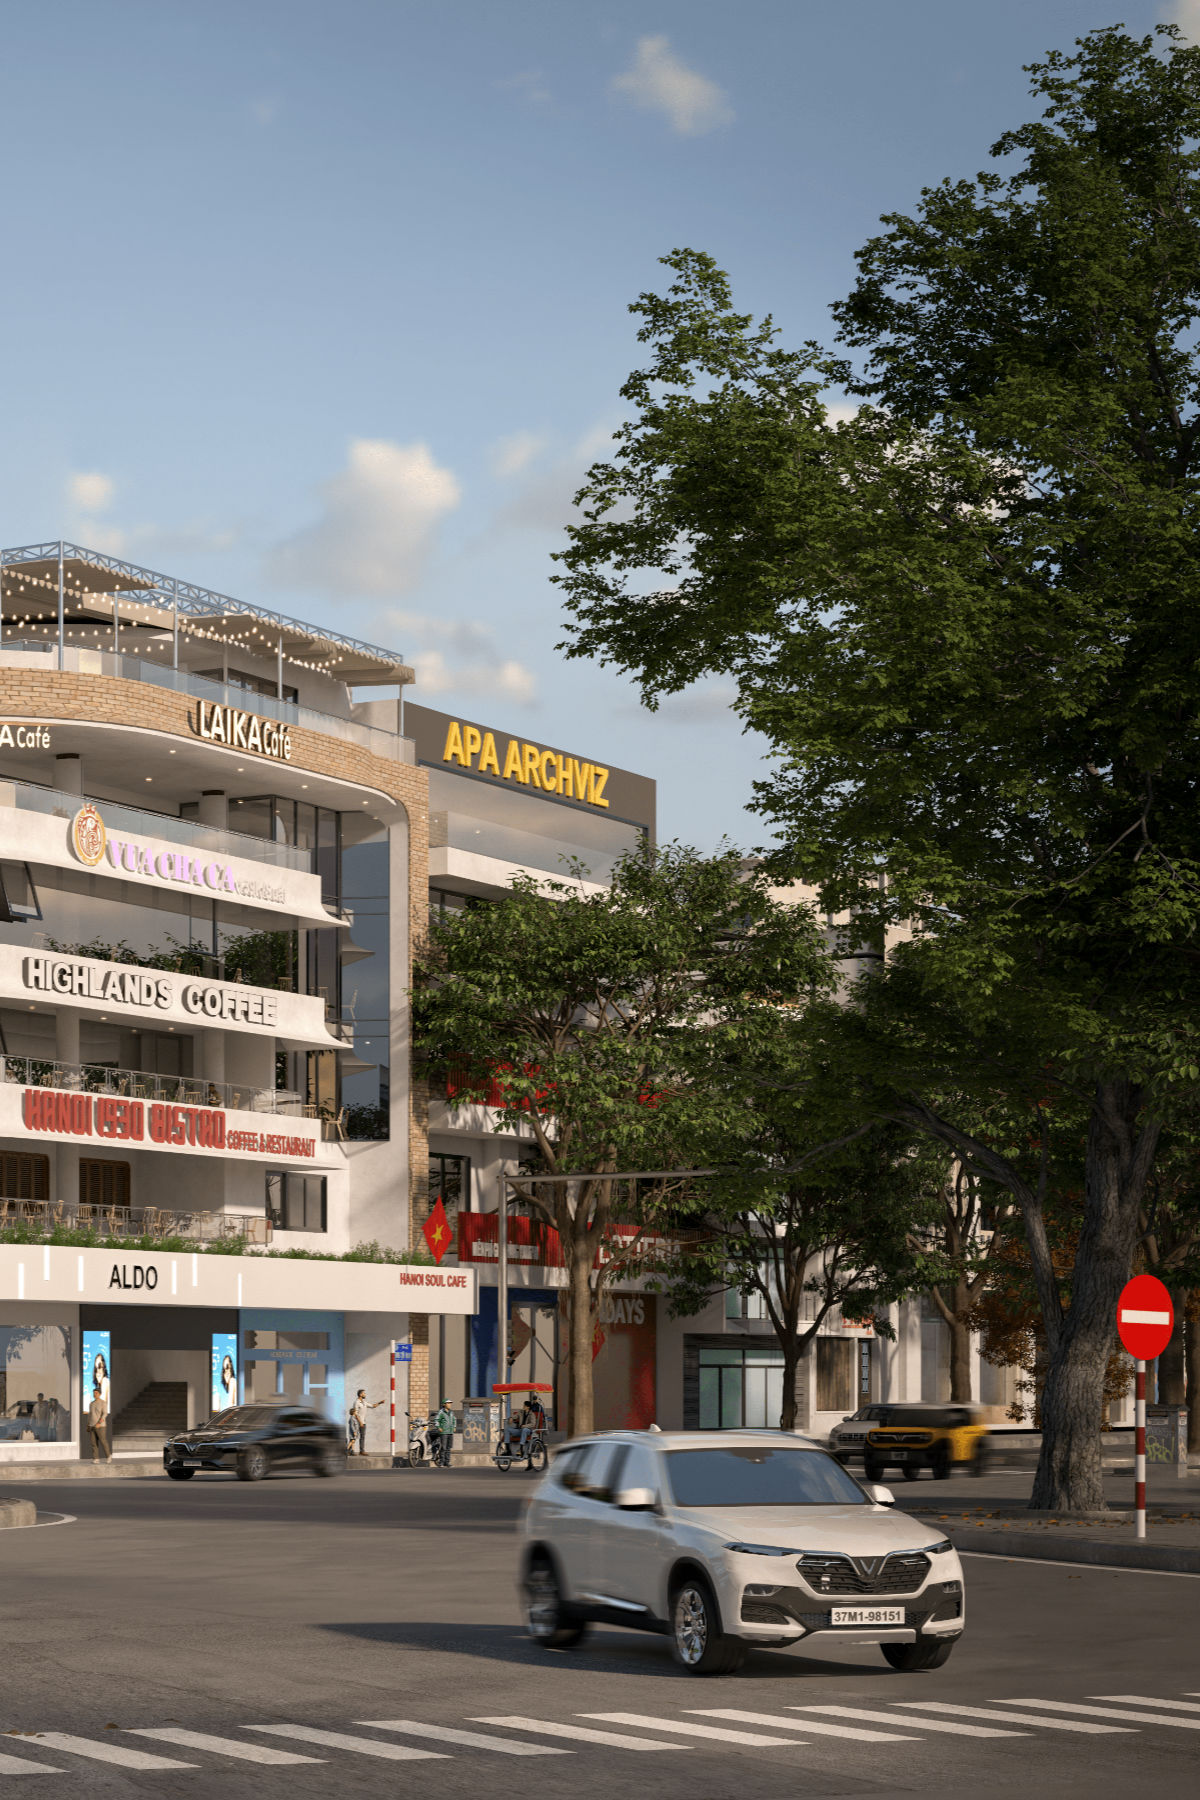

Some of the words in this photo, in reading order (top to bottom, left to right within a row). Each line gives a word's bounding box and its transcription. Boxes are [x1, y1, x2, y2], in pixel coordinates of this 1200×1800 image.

[17, 726, 50, 748] Café
[200, 700, 262, 752] LAIKA
[263, 721, 291, 760] Café
[443, 721, 500, 776] APA
[503, 740, 609, 808] ARCHVIZ
[108, 839, 156, 874] VUA
[158, 851, 205, 885] CHA
[206, 861, 237, 893] CA
[25, 957, 173, 1009] HIGHLANDS
[184, 984, 278, 1026] COFFEE
[25, 1089, 93, 1136] HANOI
[98, 1097, 145, 1141] 1930
[151, 1103, 227, 1149] BISTRO
[228, 1129, 259, 1152] COFFEE
[109, 1264, 158, 1289] ALDO
[400, 1273, 424, 1286] HANOI
[425, 1274, 446, 1287] SOUL
[447, 1275, 467, 1288] CAFE
[833, 1610, 901, 1622] 37M1-98151
